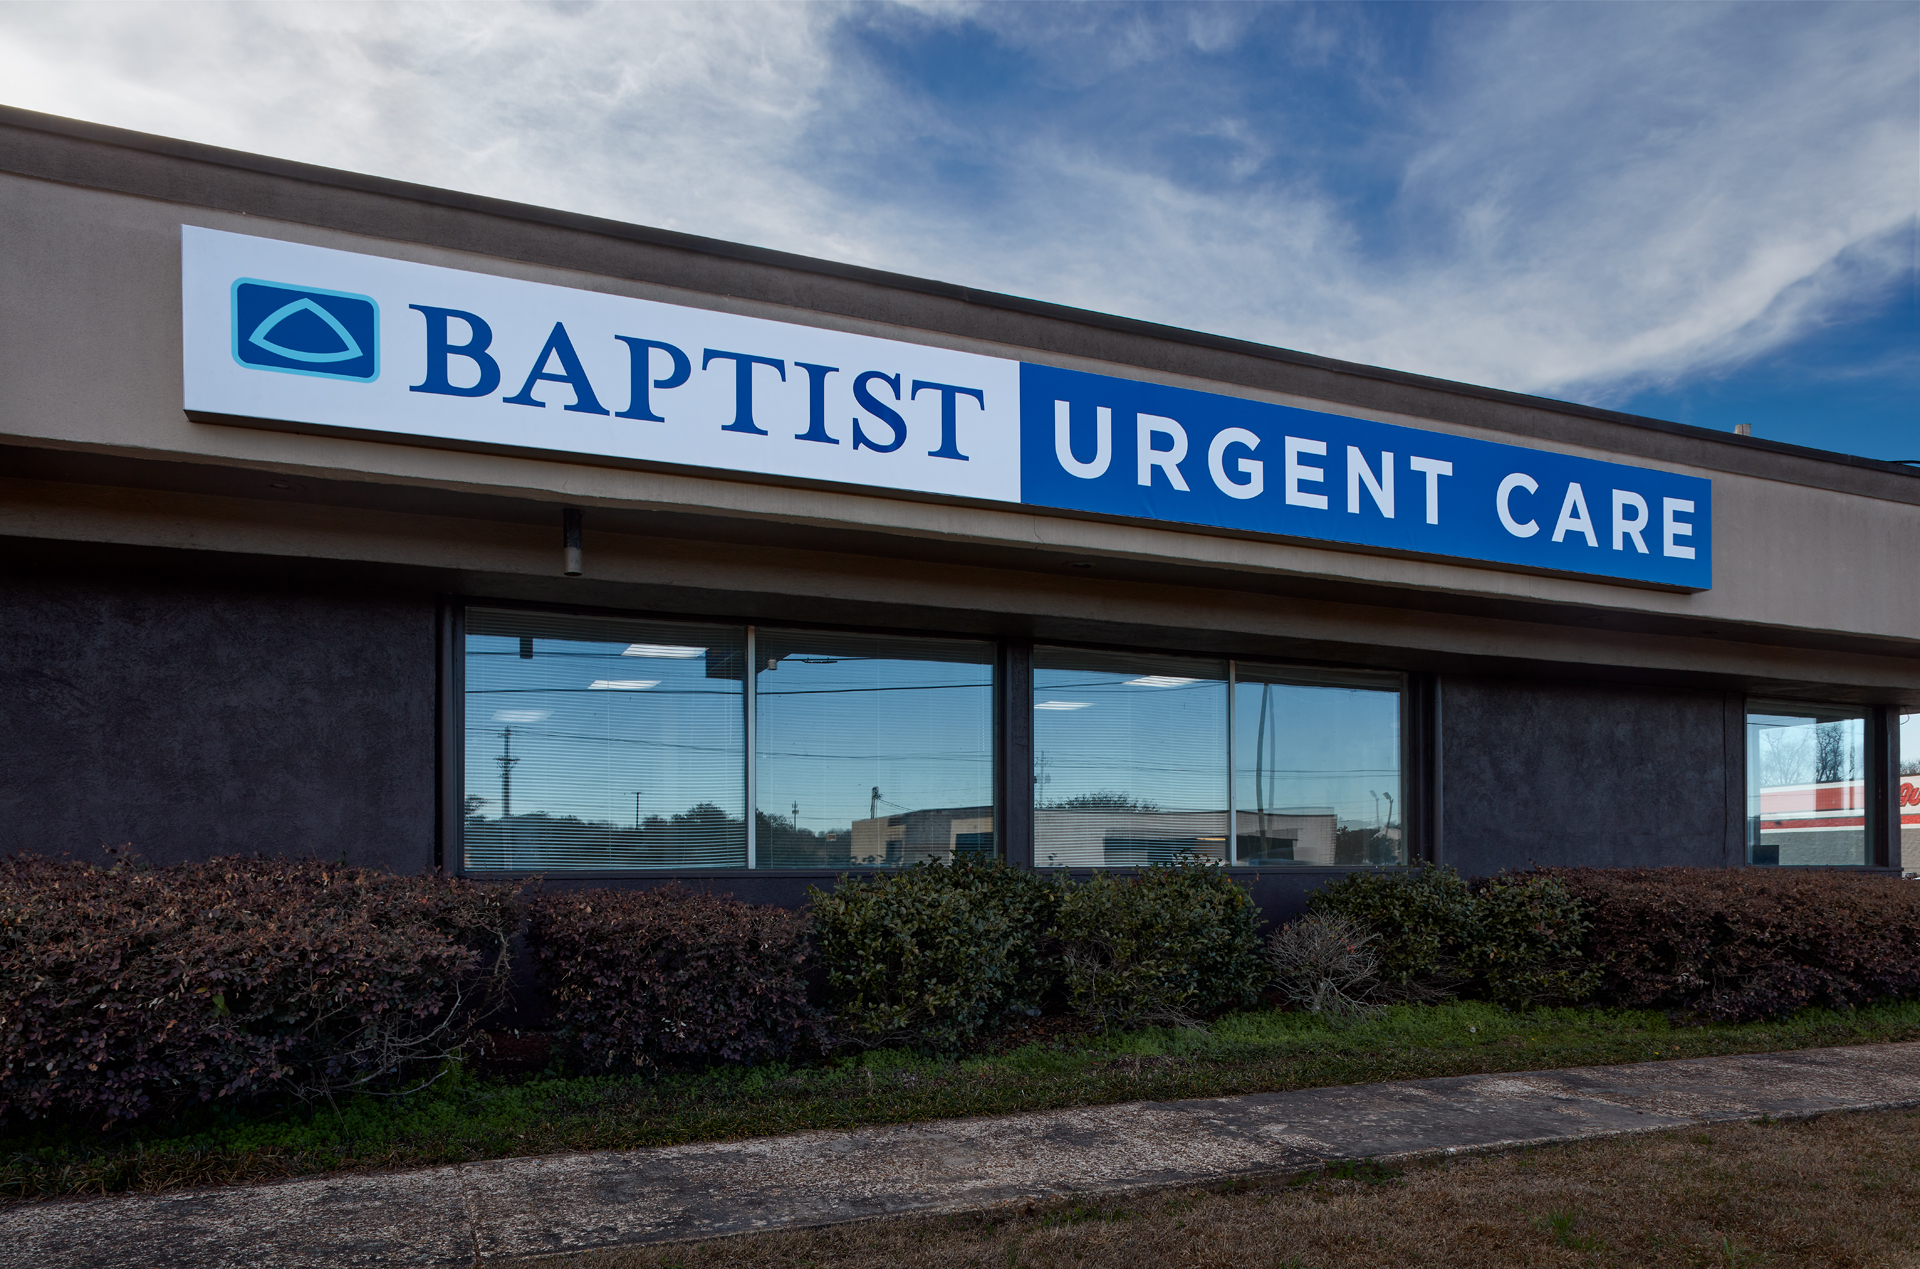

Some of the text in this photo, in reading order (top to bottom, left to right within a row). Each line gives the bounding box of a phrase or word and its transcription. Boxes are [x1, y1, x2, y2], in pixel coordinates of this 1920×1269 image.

[409, 303, 1696, 560] BAPTIST URGENT CARE
